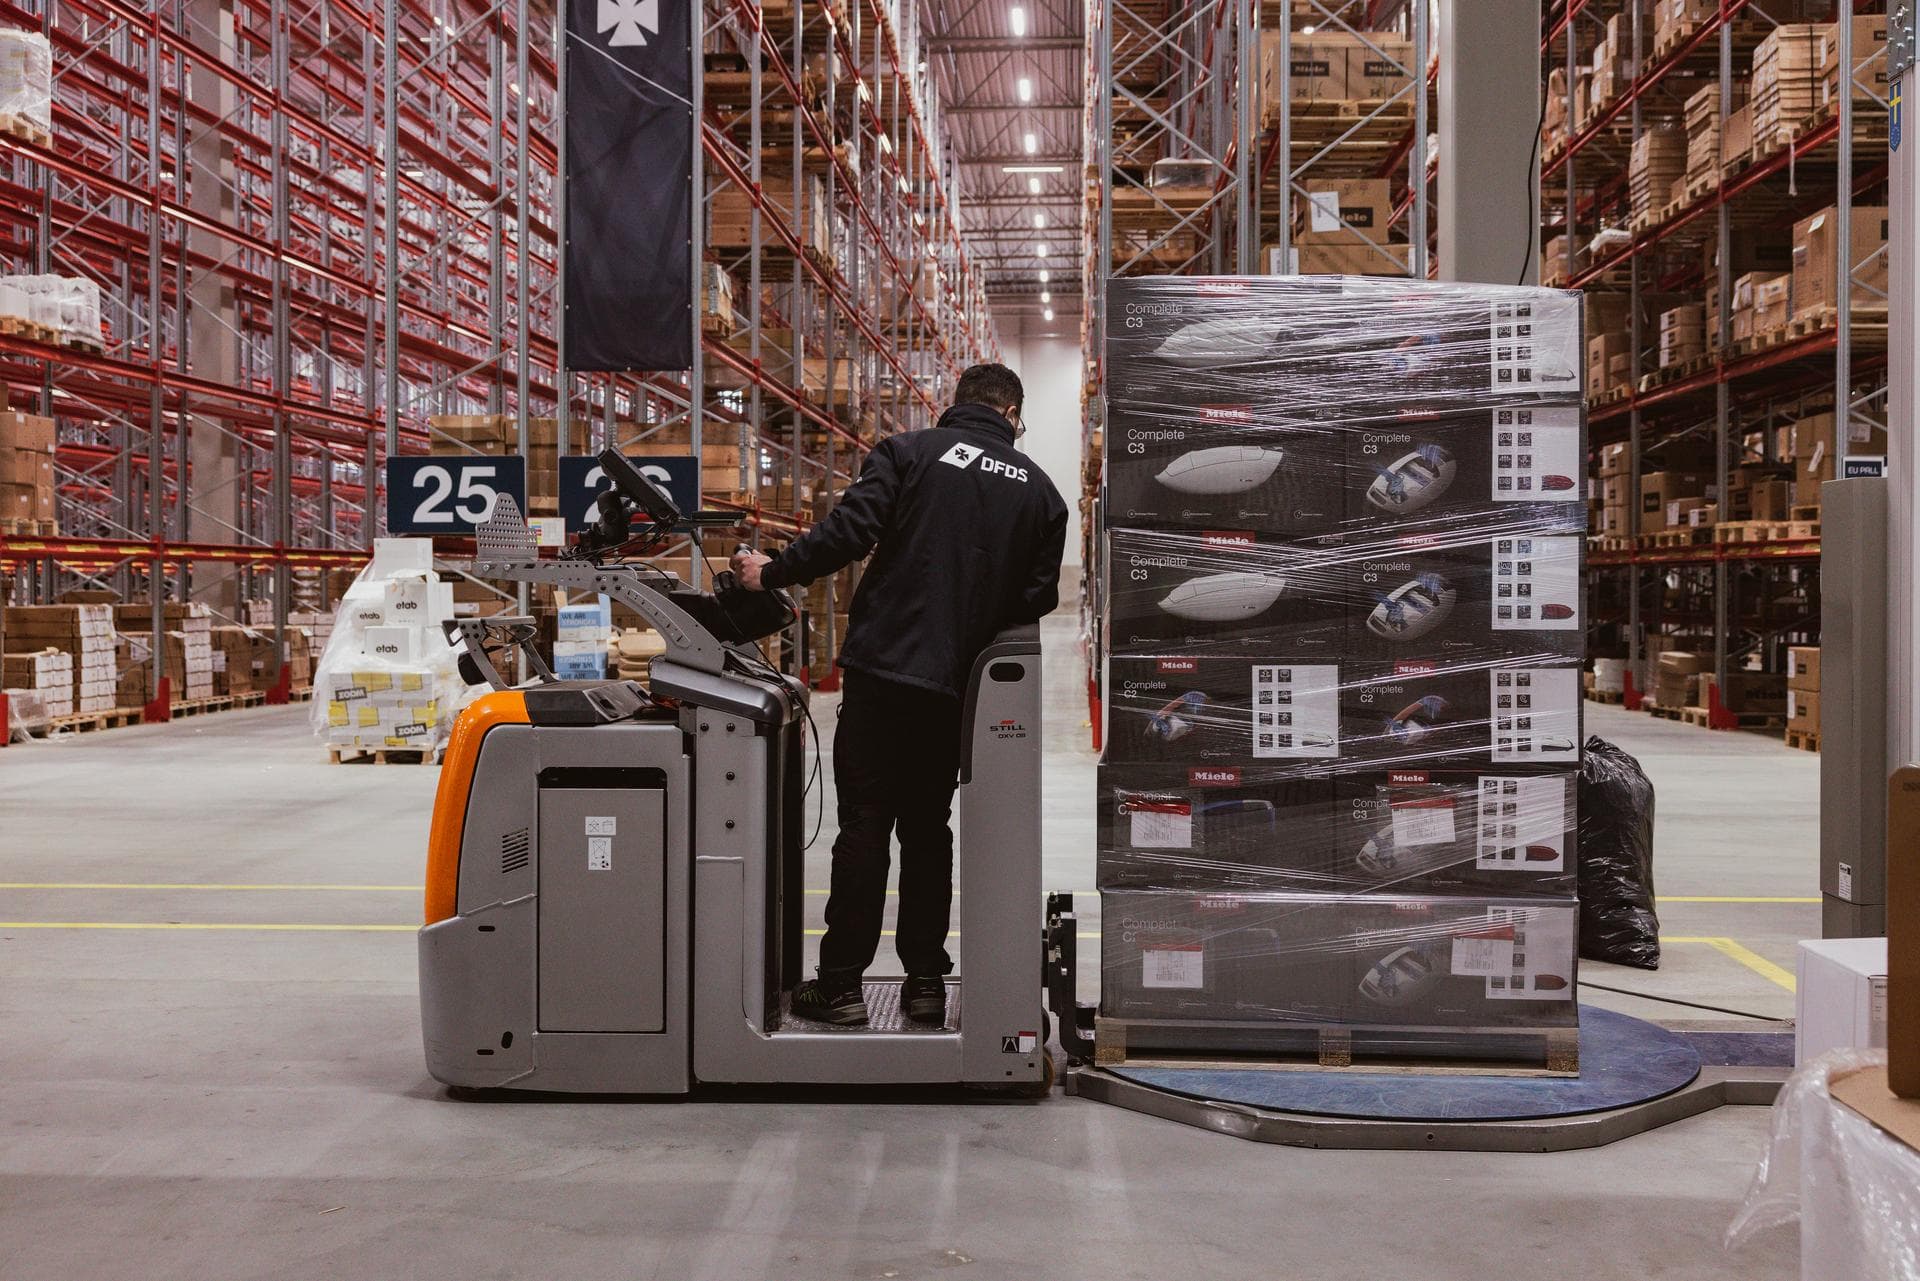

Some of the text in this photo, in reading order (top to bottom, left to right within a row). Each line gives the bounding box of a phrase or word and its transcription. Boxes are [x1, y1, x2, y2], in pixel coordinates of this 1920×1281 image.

[1341, 212, 1368, 222] iele
[1125, 303, 1183, 315] Complete
[1126, 317, 1144, 328] C3
[1127, 428, 1185, 442] Complete
[1363, 433, 1411, 444] Complete
[1127, 443, 1145, 454] C3
[1363, 445, 1378, 454] C3
[980, 456, 1029, 483] DFDS
[412, 465, 498, 524] 25
[1208, 537, 1249, 545] Miele
[1130, 555, 1188, 568] Complete
[1363, 561, 1411, 572] Complete
[1130, 569, 1148, 580] C3
[1363, 573, 1378, 582] C3
[396, 601, 418, 610] etab
[359, 612, 380, 620] etab
[376, 644, 398, 653] etab
[1161, 661, 1193, 669] Miele
[1123, 680, 1167, 690] Complete
[1360, 685, 1404, 695] Complete
[337, 690, 365, 699] ZOOM
[1123, 690, 1137, 698] C2
[1360, 694, 1374, 703] C2
[397, 725, 425, 735] ZOOM
[1194, 771, 1235, 781] Miele
[1392, 774, 1425, 782] Miele
[1352, 798, 1389, 810] Compl
[1353, 810, 1368, 819] C3
[1199, 899, 1240, 908] Miele
[1396, 902, 1428, 910] Miele
[1122, 917, 1177, 931] Compact
